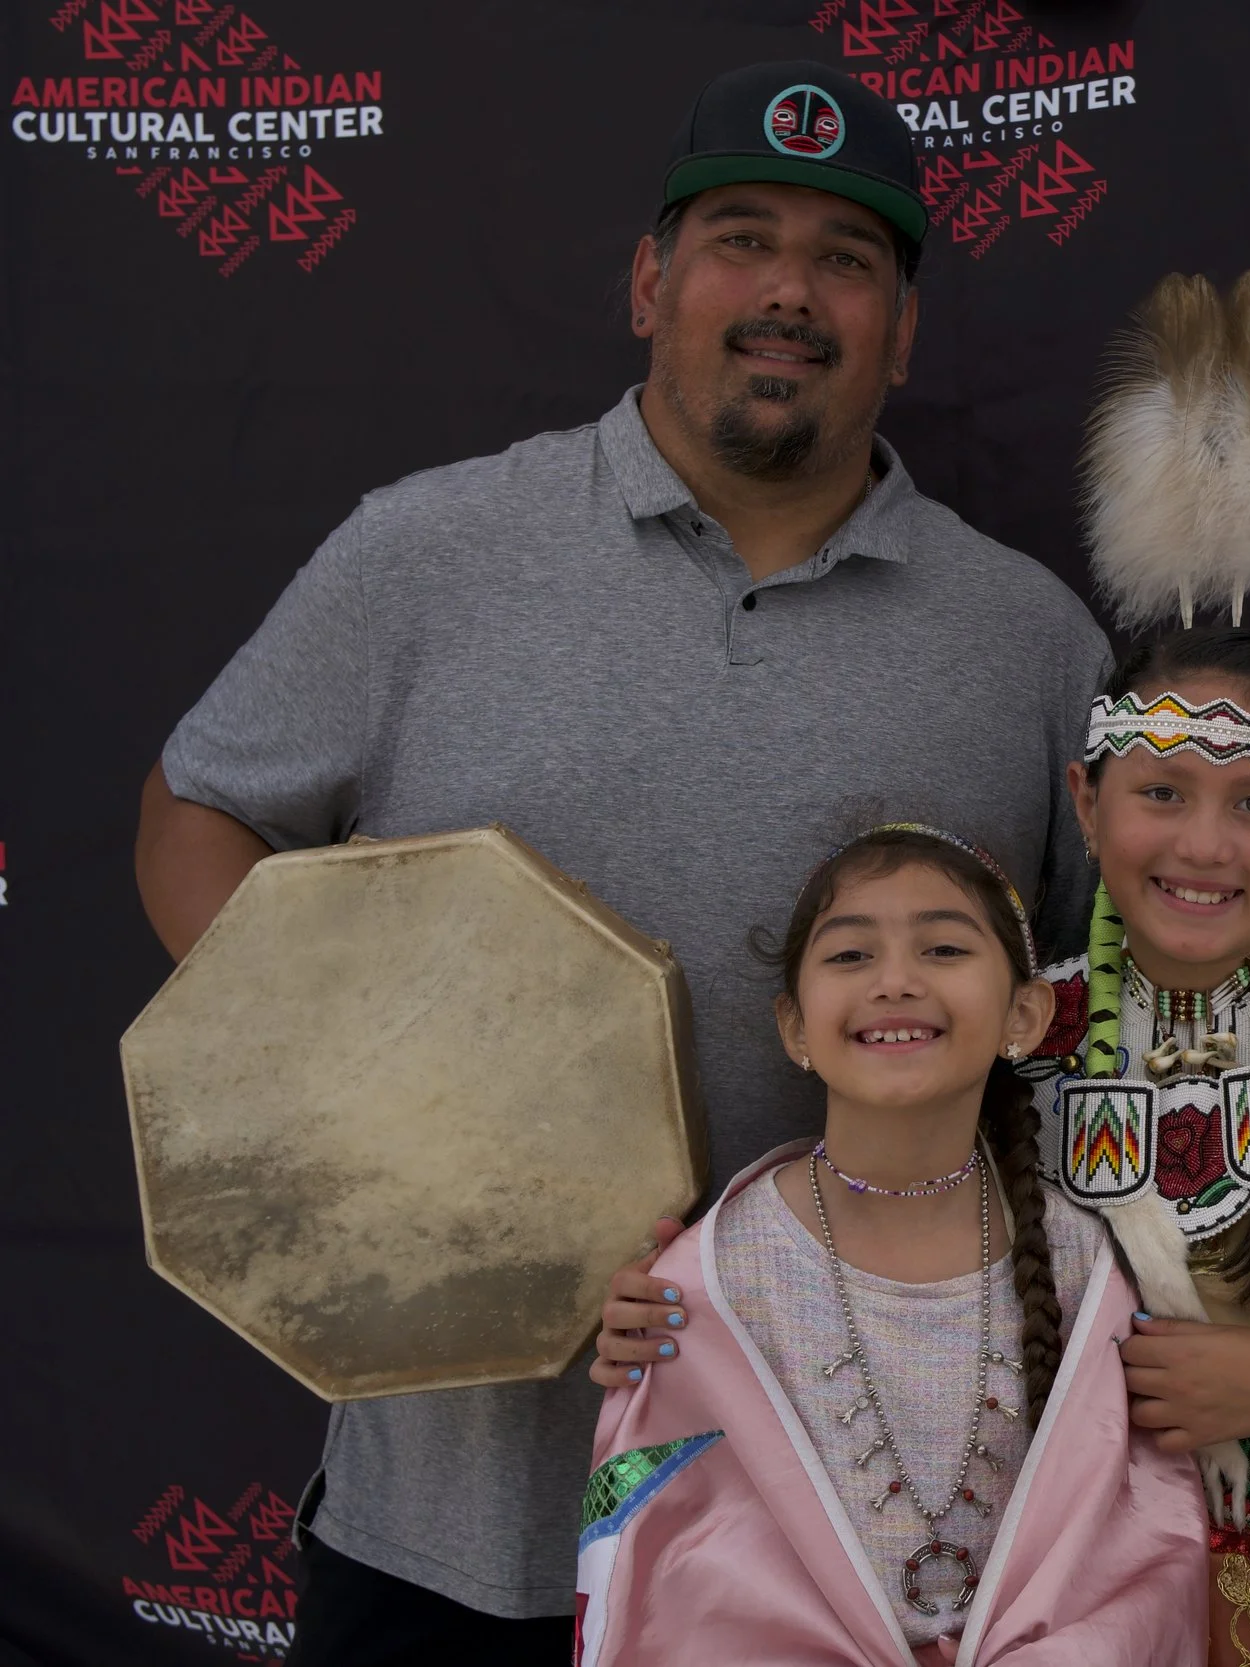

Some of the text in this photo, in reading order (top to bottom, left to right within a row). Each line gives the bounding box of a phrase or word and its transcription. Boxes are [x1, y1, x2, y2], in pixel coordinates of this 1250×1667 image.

[848, 39, 1135, 100] RICAN INDIAN
[11, 70, 383, 109] AMERICAN INDIAN
[982, 75, 1137, 125] CENTER
[12, 105, 384, 143] CULTURAL CENTER
[910, 120, 1064, 150] RANCISCO
